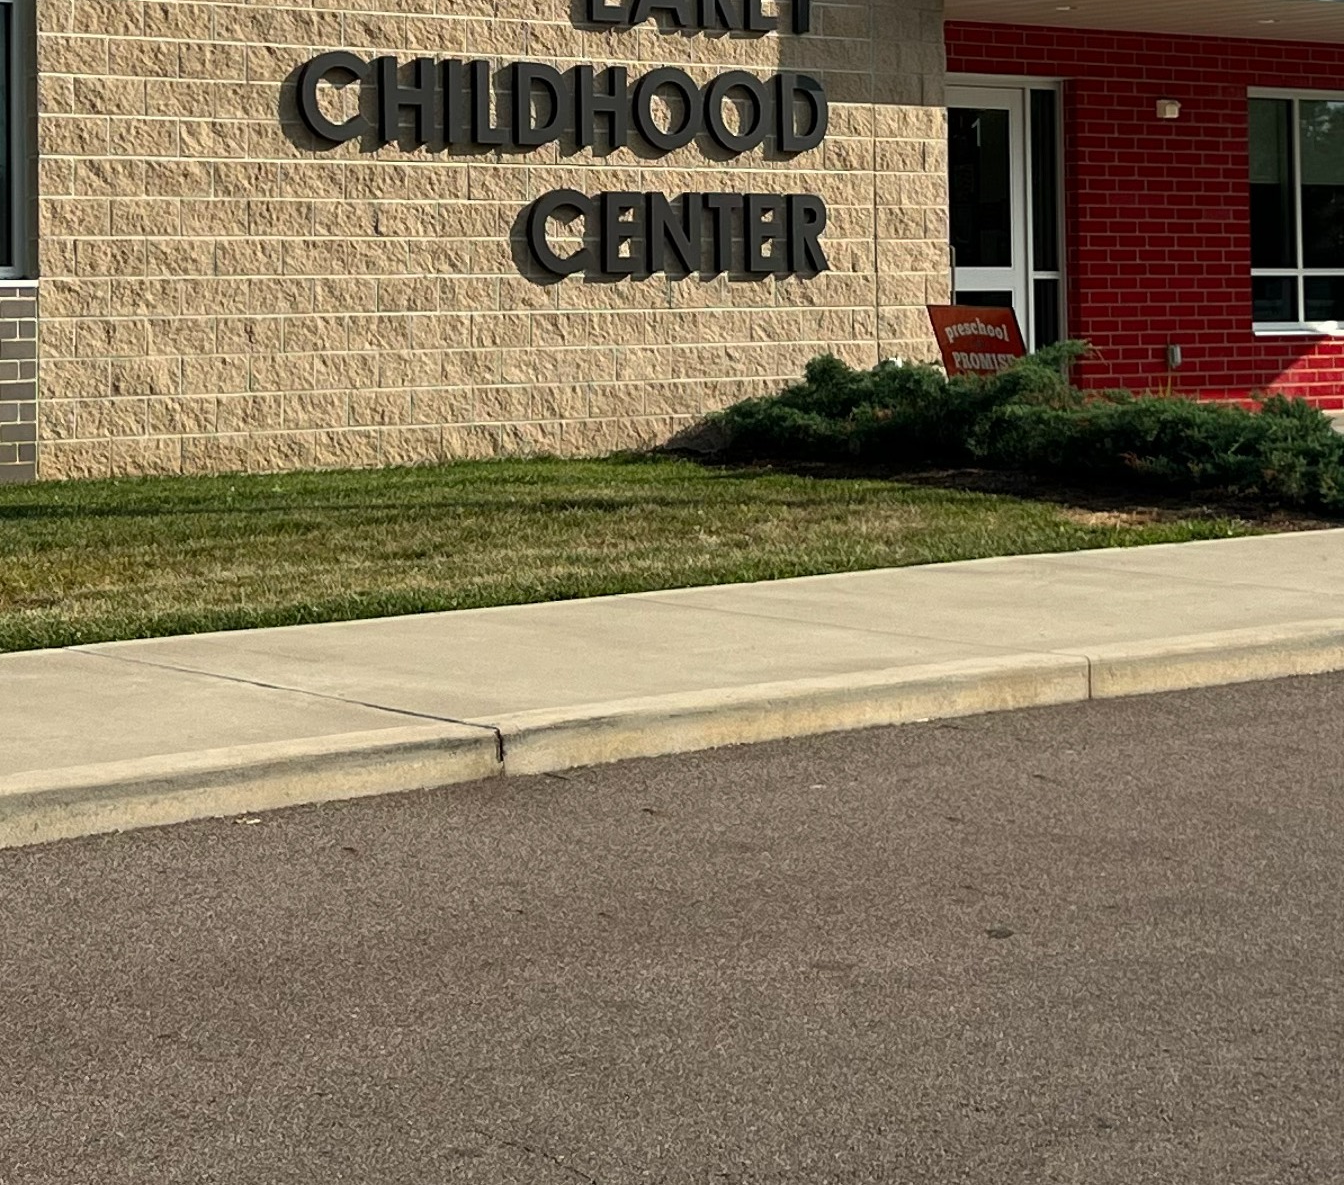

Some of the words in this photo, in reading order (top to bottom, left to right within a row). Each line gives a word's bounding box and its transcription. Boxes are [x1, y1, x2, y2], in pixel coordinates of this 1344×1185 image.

[298, 52, 829, 152] CHILDHOOD
[527, 189, 829, 275] CENTER
[944, 317, 1010, 343] preschool
